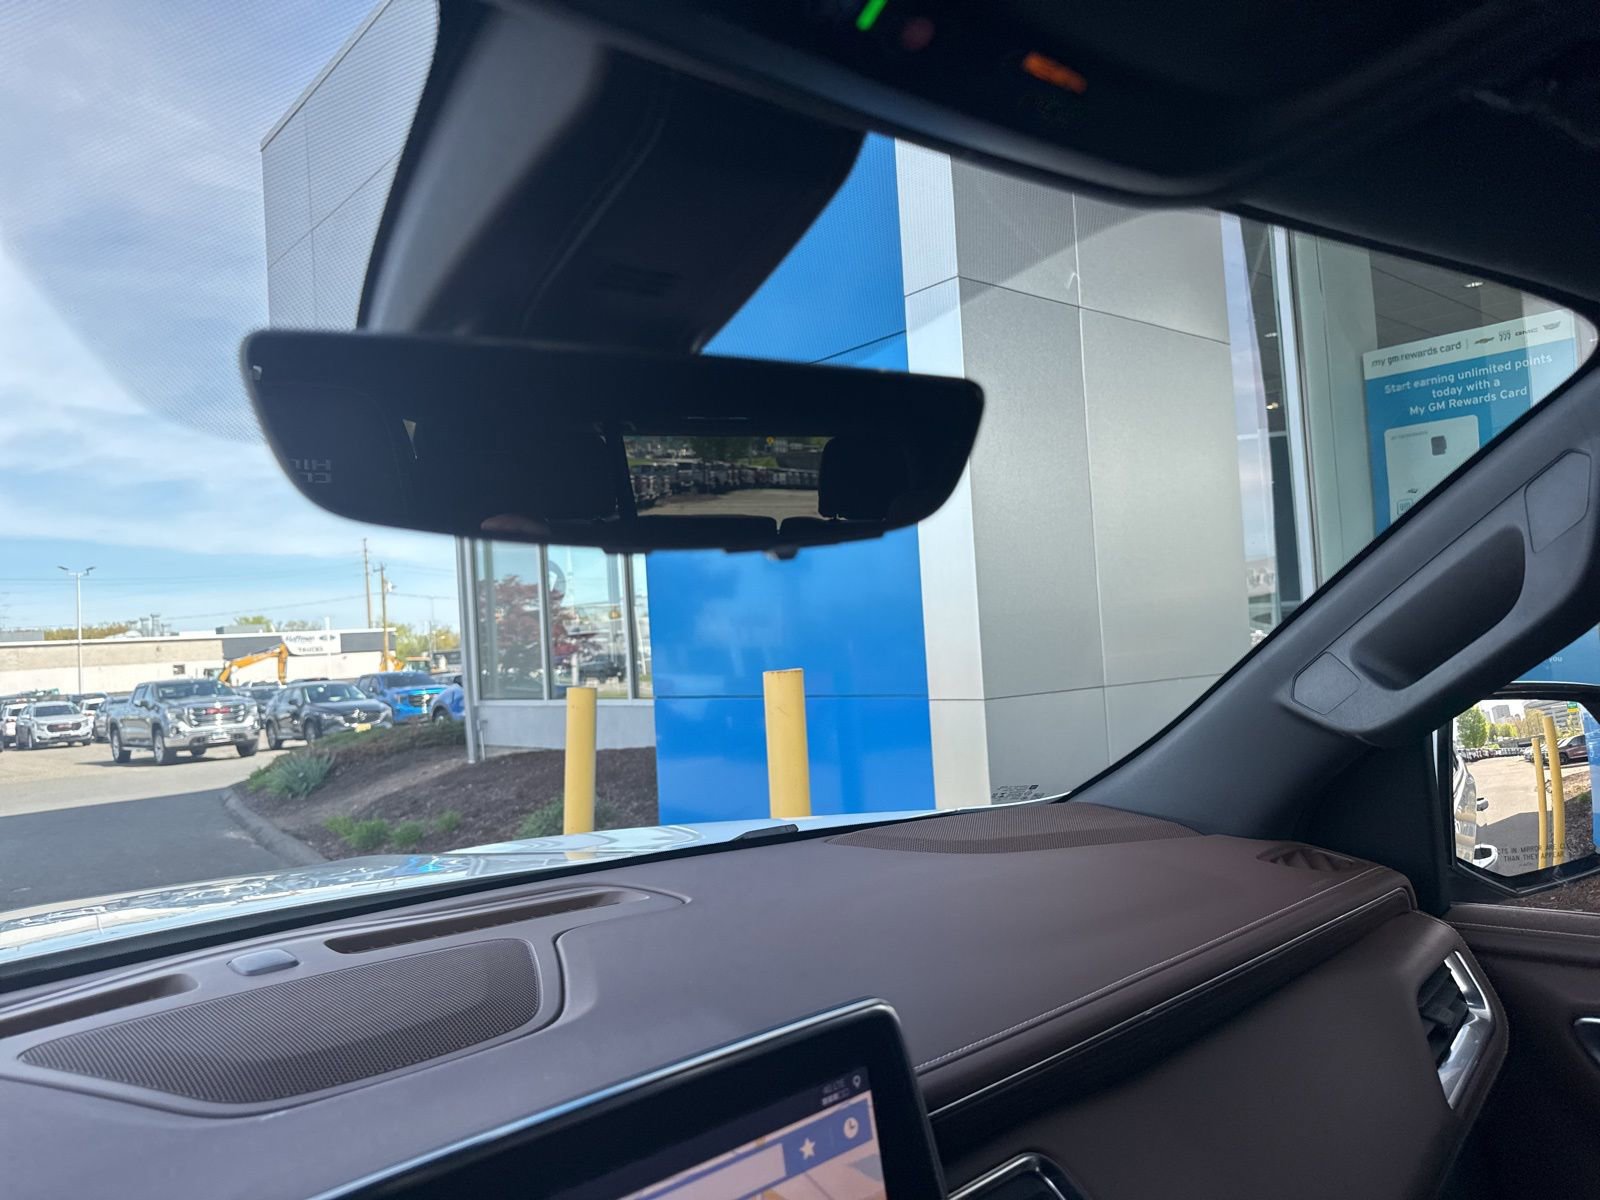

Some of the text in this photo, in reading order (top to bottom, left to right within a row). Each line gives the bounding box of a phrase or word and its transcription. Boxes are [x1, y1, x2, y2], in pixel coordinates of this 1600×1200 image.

[1371, 341, 1462, 368] my gm rewards card
[1384, 353, 1553, 394] Start earning unlimited points
[1409, 386, 1528, 416] My GM Rewards Card
[1431, 379, 1501, 398] today with a
